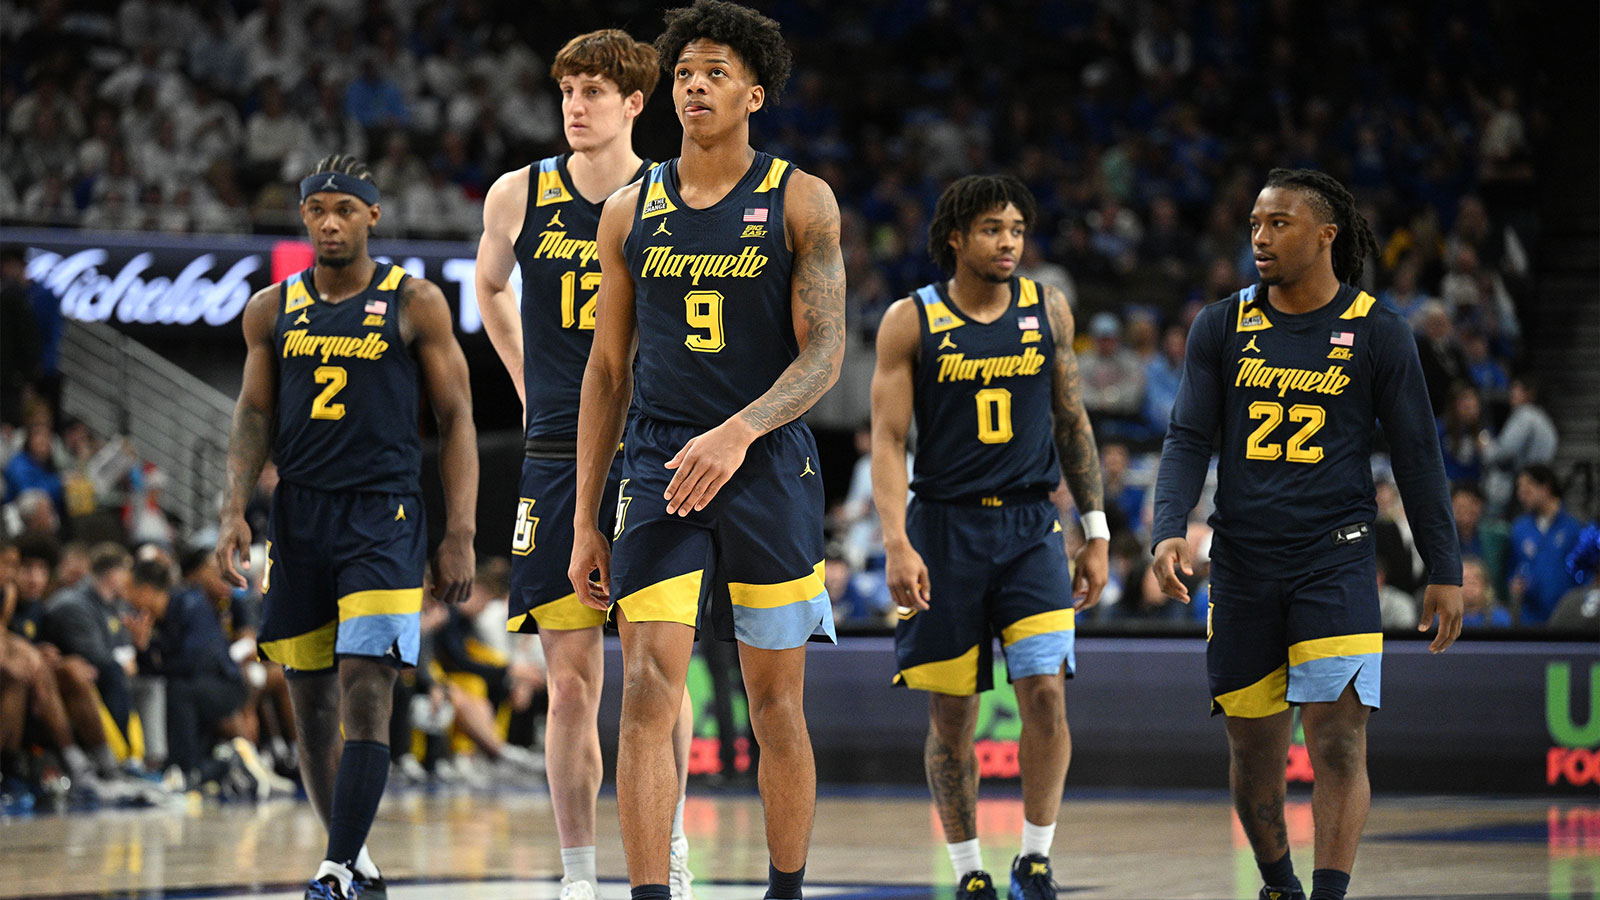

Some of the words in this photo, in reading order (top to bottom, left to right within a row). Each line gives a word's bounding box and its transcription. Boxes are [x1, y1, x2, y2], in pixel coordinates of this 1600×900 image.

[534, 231, 598, 267] Marq
[641, 246, 768, 286] Marquette
[25, 247, 263, 326] Michelob
[561, 271, 602, 329] 12
[684, 290, 725, 353] 9
[283, 329, 389, 363] Marquette
[937, 347, 1045, 386] Marquette
[311, 366, 347, 420] 2
[1235, 357, 1350, 397] Marquette
[975, 388, 1014, 444] 0
[1246, 401, 1326, 463] 22
[1546, 747, 1600, 786] FO
